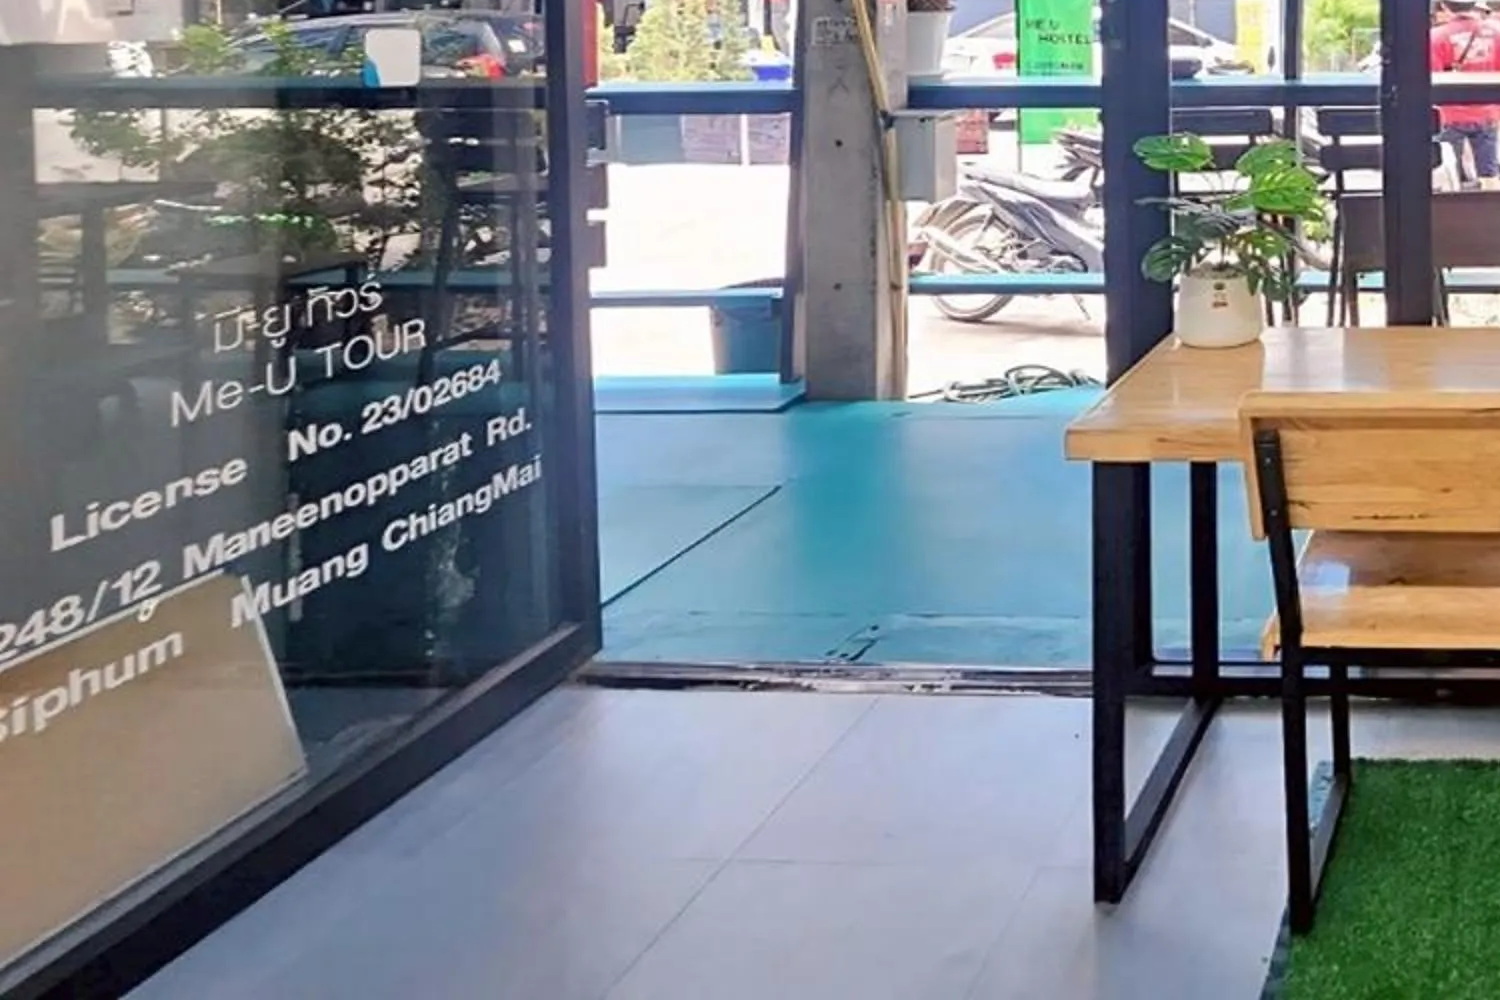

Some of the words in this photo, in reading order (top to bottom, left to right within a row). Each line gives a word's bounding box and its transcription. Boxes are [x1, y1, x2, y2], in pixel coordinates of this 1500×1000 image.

[50, 456, 249, 552] License
[288, 422, 352, 462] No.
[361, 358, 502, 434] 23/02684
[170, 356, 297, 428] Me-U
[315, 318, 427, 379] TOUR
[182, 432, 473, 579] Maneenopparat
[486, 406, 533, 447] Rd.
[230, 540, 370, 629] Muang
[381, 454, 543, 552] ChiangMai
